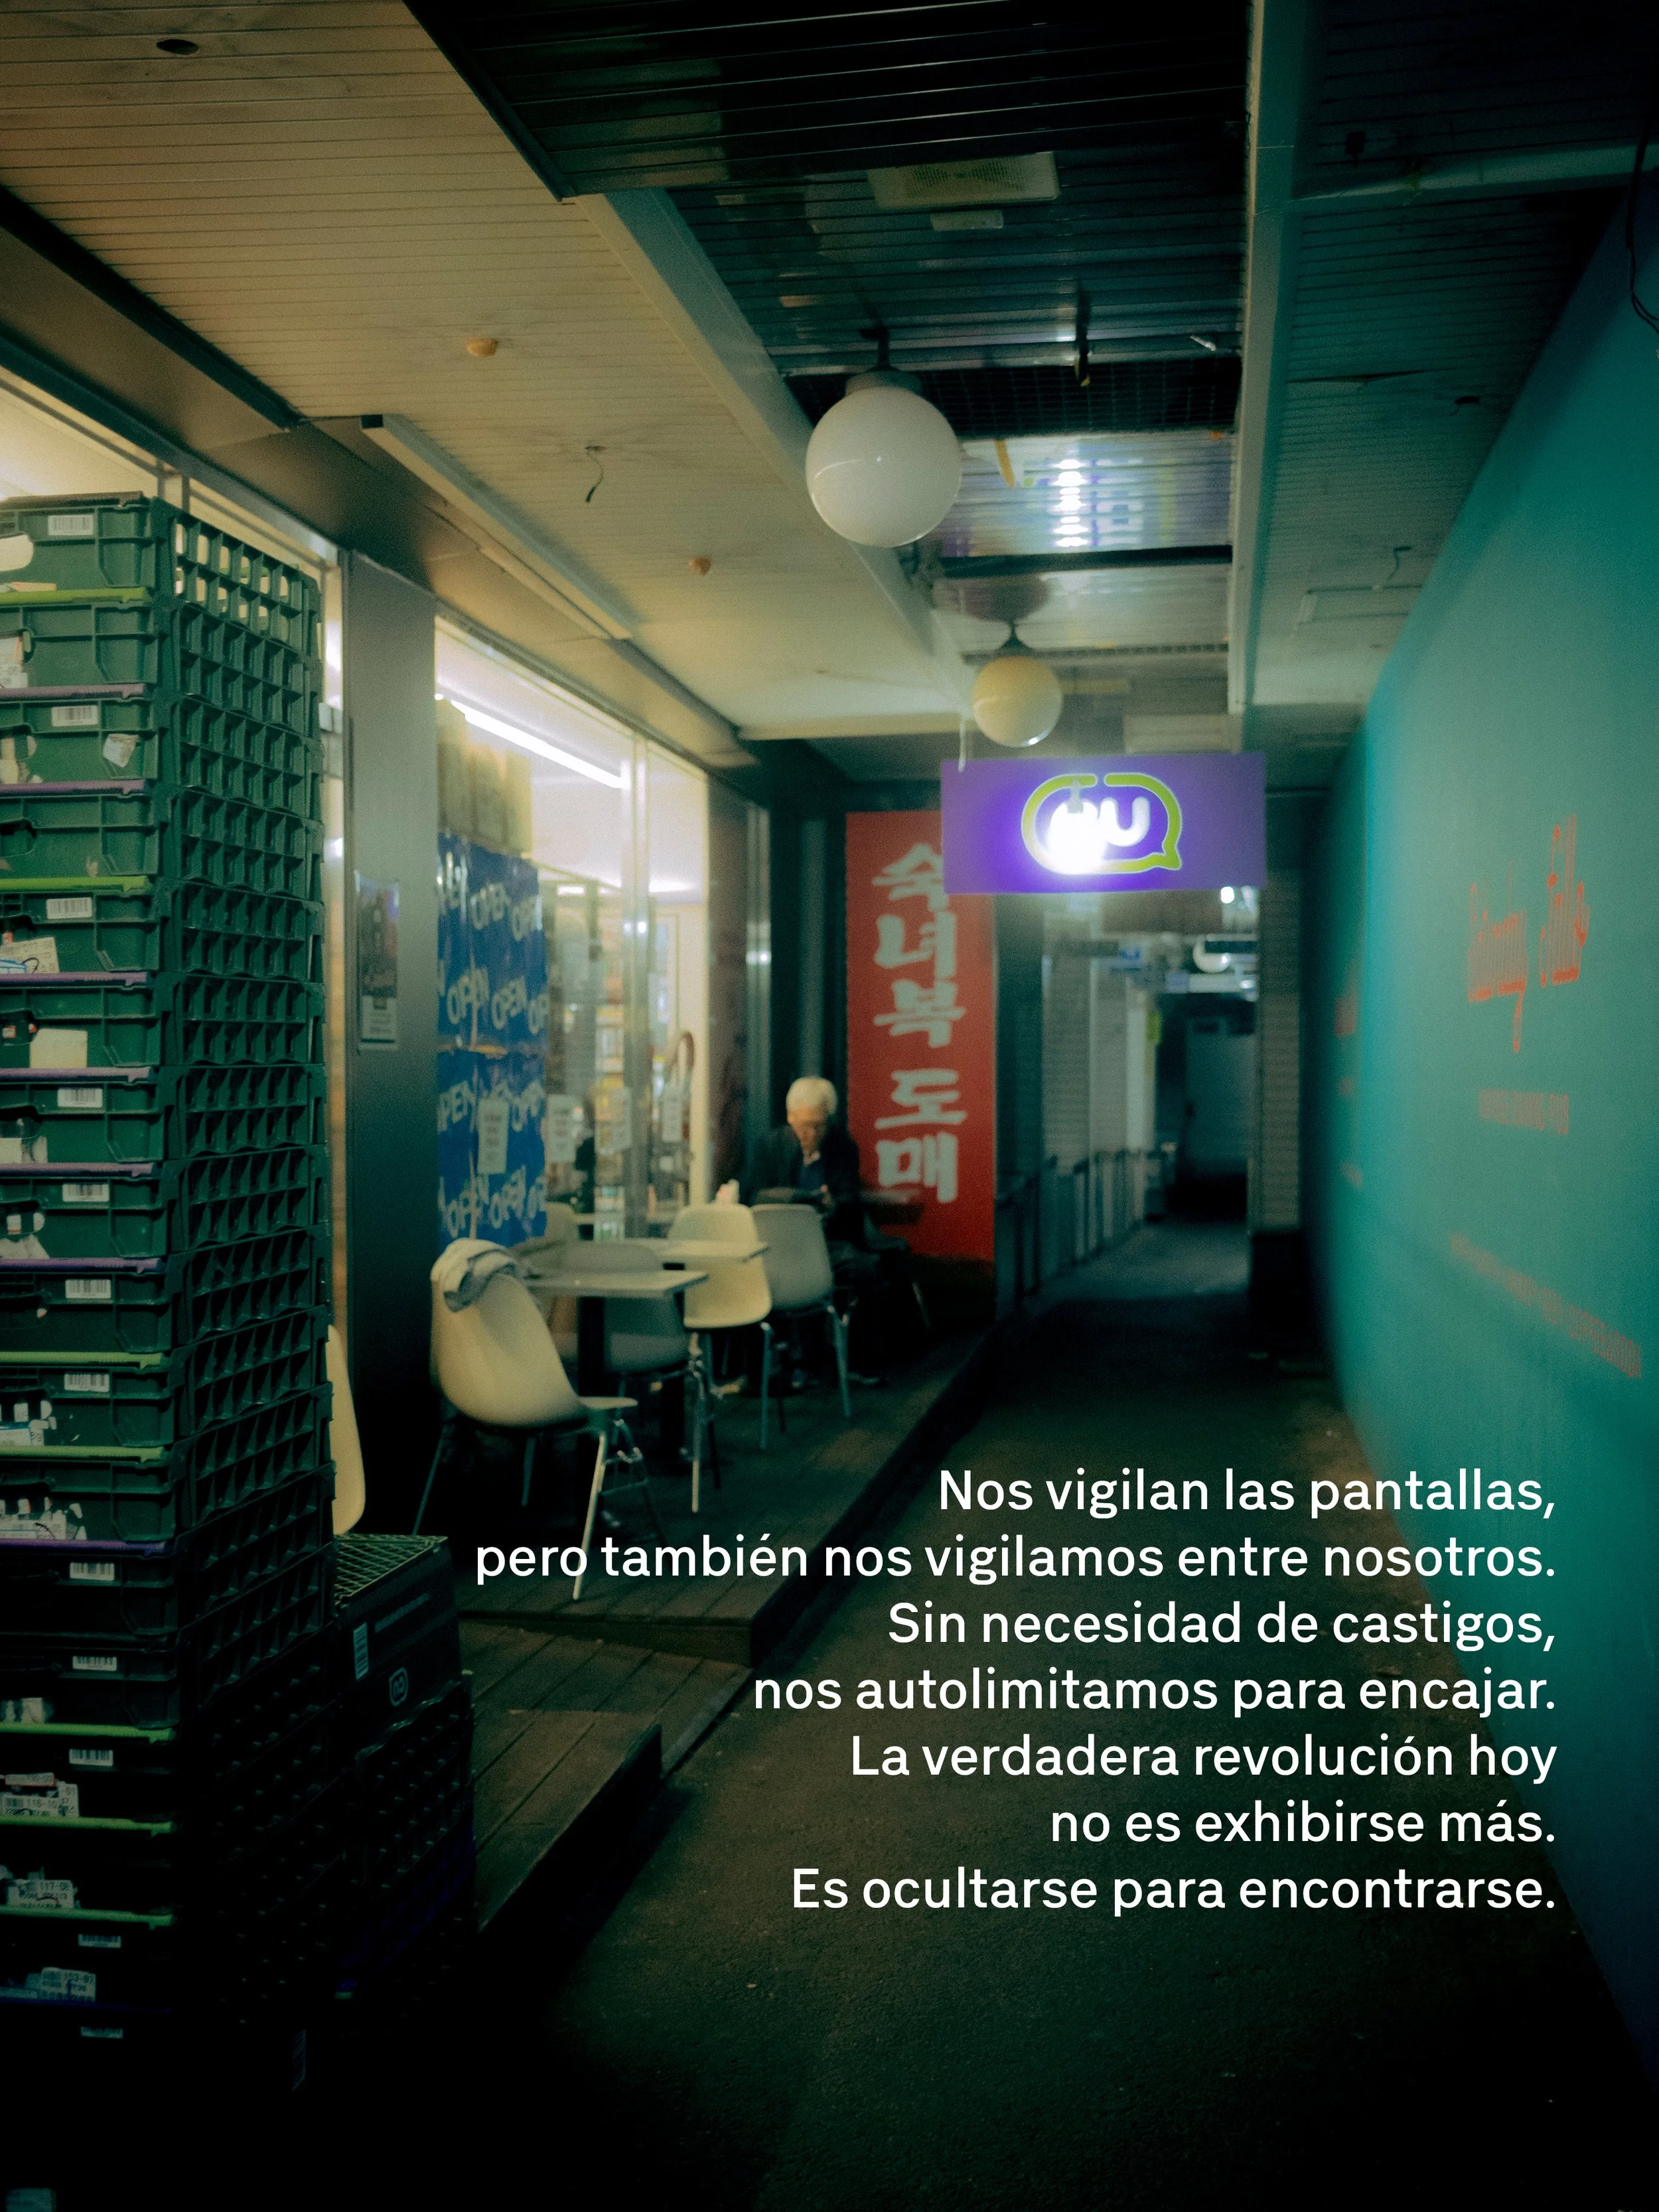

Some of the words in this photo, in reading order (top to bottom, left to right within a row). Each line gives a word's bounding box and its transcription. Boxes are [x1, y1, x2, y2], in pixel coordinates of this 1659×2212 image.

[492, 976, 527, 1030] OPEN
[872, 842, 965, 1048] 숙녀복
[875, 1069, 968, 1203] 도매
